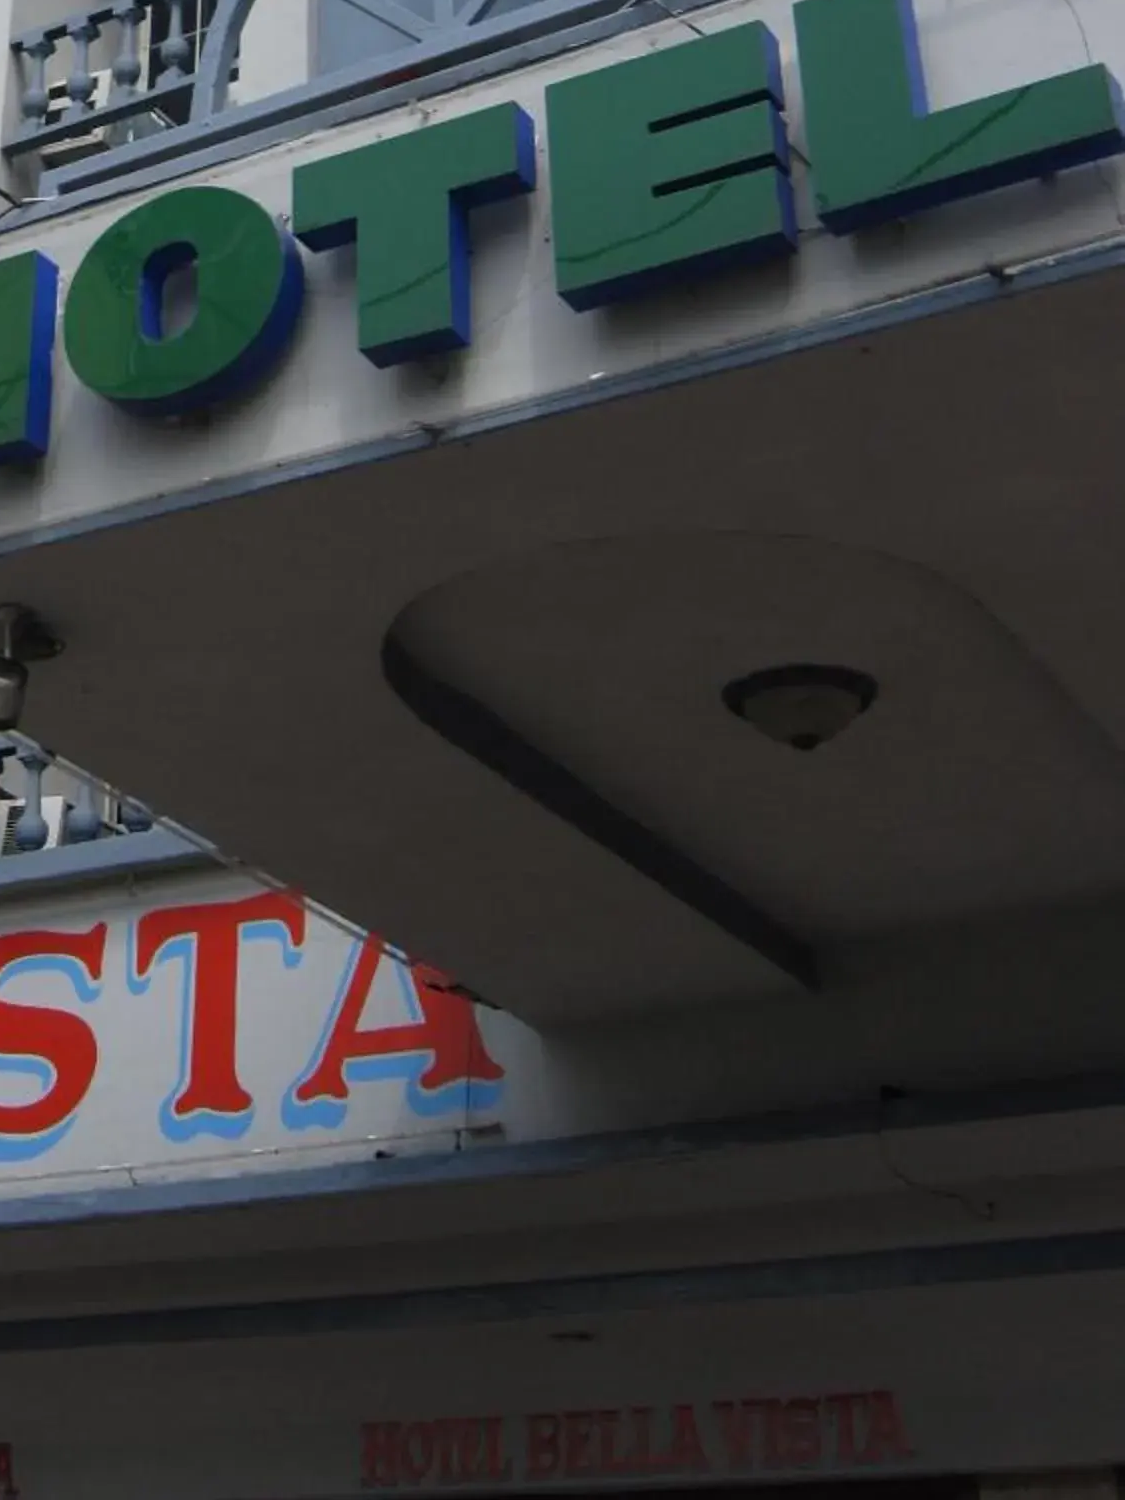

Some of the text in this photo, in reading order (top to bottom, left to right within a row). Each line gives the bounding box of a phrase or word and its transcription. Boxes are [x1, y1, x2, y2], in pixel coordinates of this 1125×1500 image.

[360, 1389, 918, 1487] HOTEL BELLA VISTA
